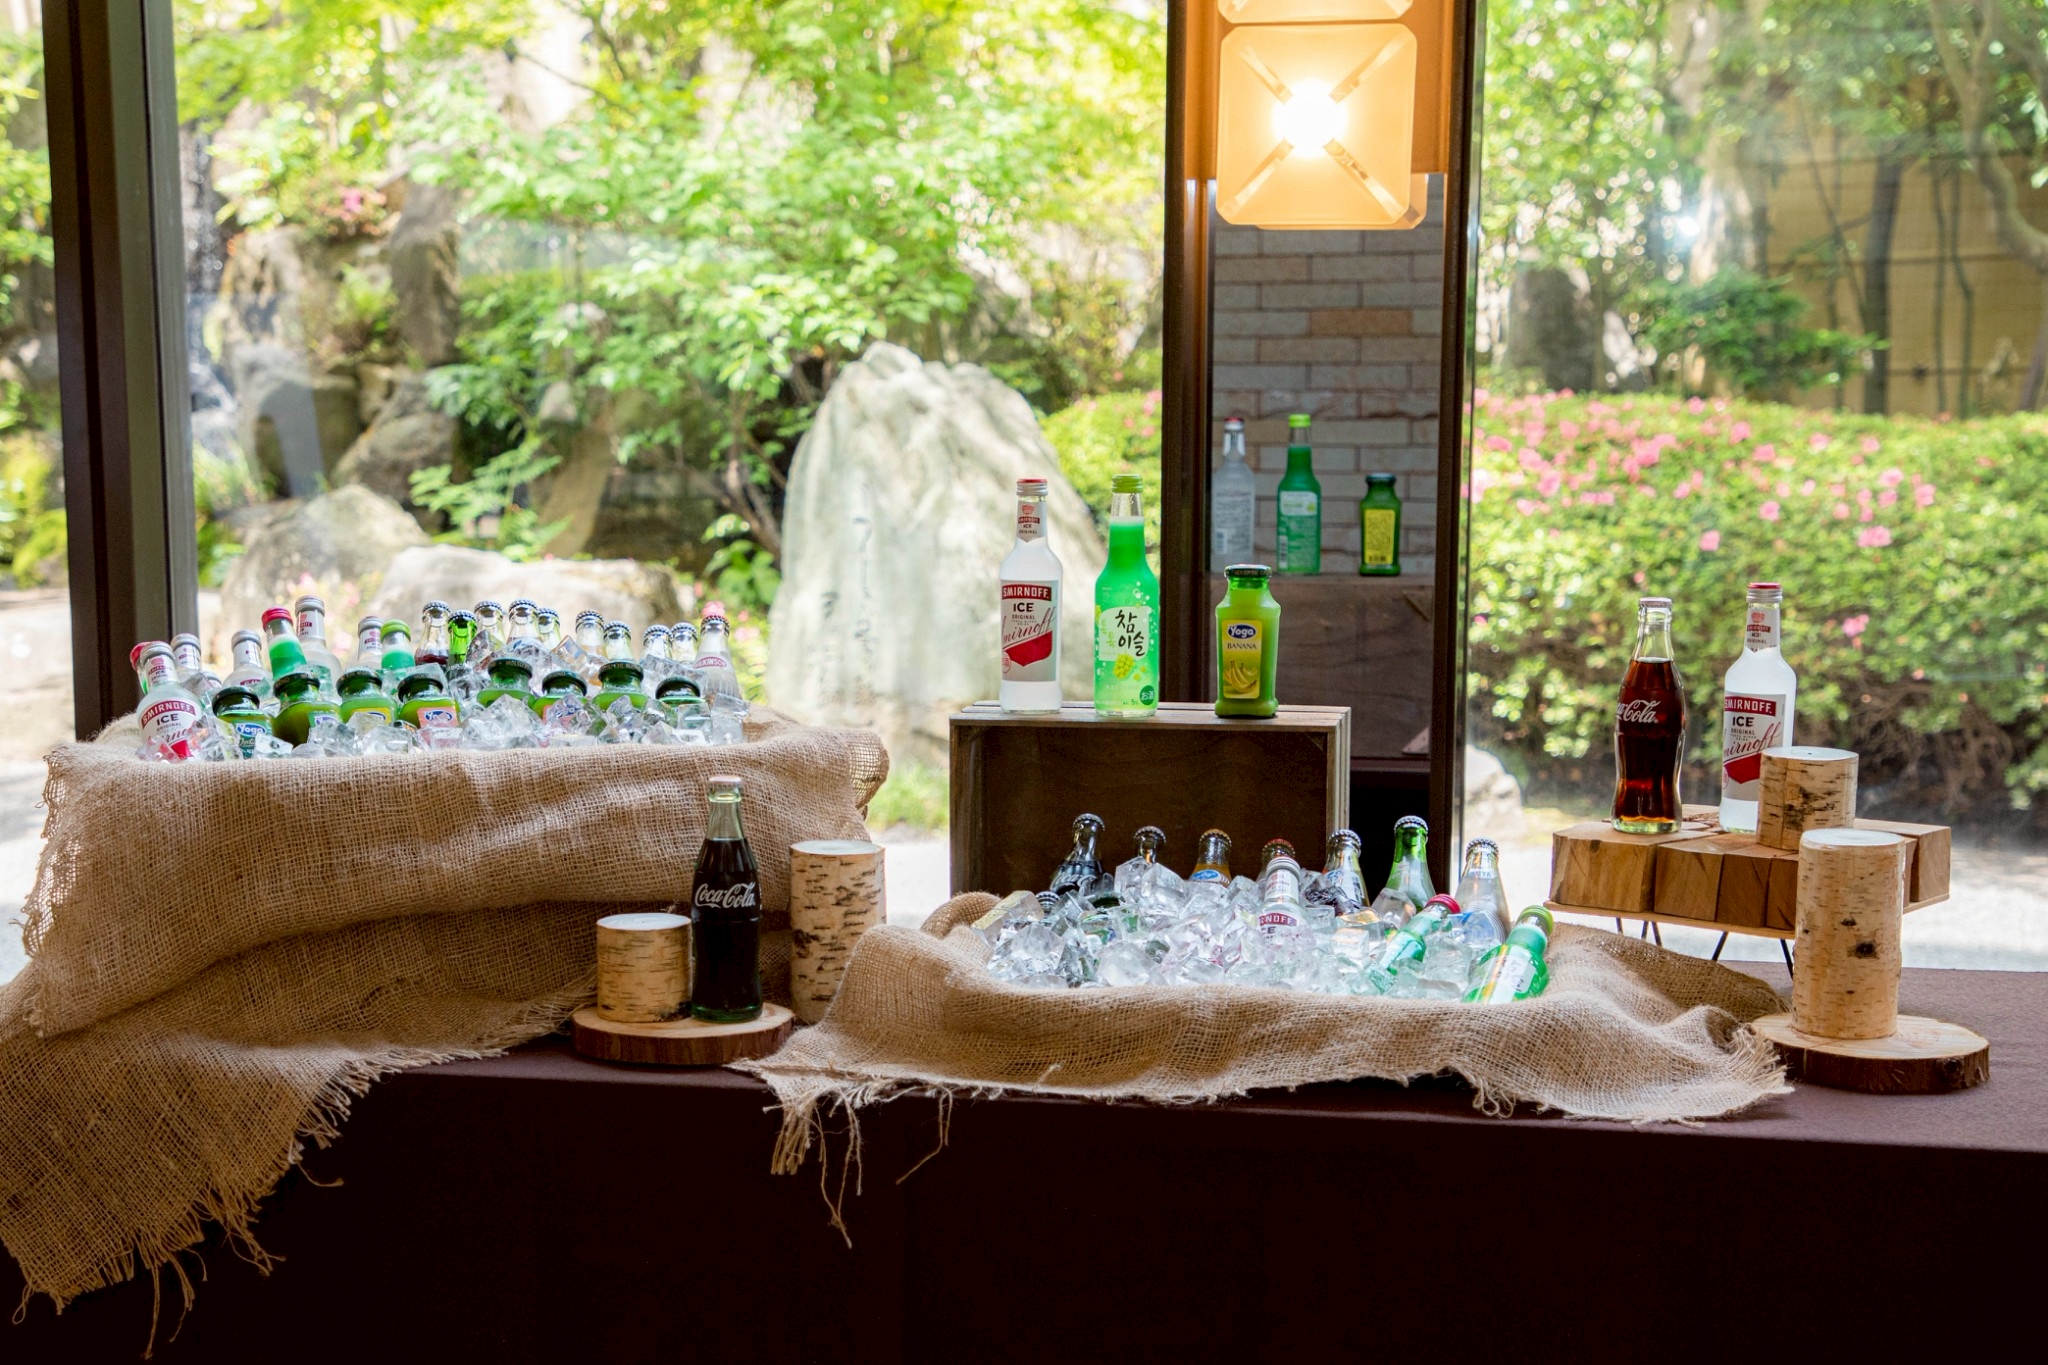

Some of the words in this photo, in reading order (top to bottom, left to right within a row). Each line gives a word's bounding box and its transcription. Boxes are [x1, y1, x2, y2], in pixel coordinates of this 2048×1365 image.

[1003, 586, 1049, 598] SMIRNOFF
[1013, 602, 1034, 612] ICE
[1115, 609, 1138, 633] 참
[1230, 625, 1254, 638] Yoga
[1118, 631, 1146, 657] 이슬
[142, 702, 192, 724] SMIRNOFF
[157, 713, 179, 725] ICE
[1733, 716, 1754, 727] ICE
[695, 882, 755, 908] Coca-Cola
